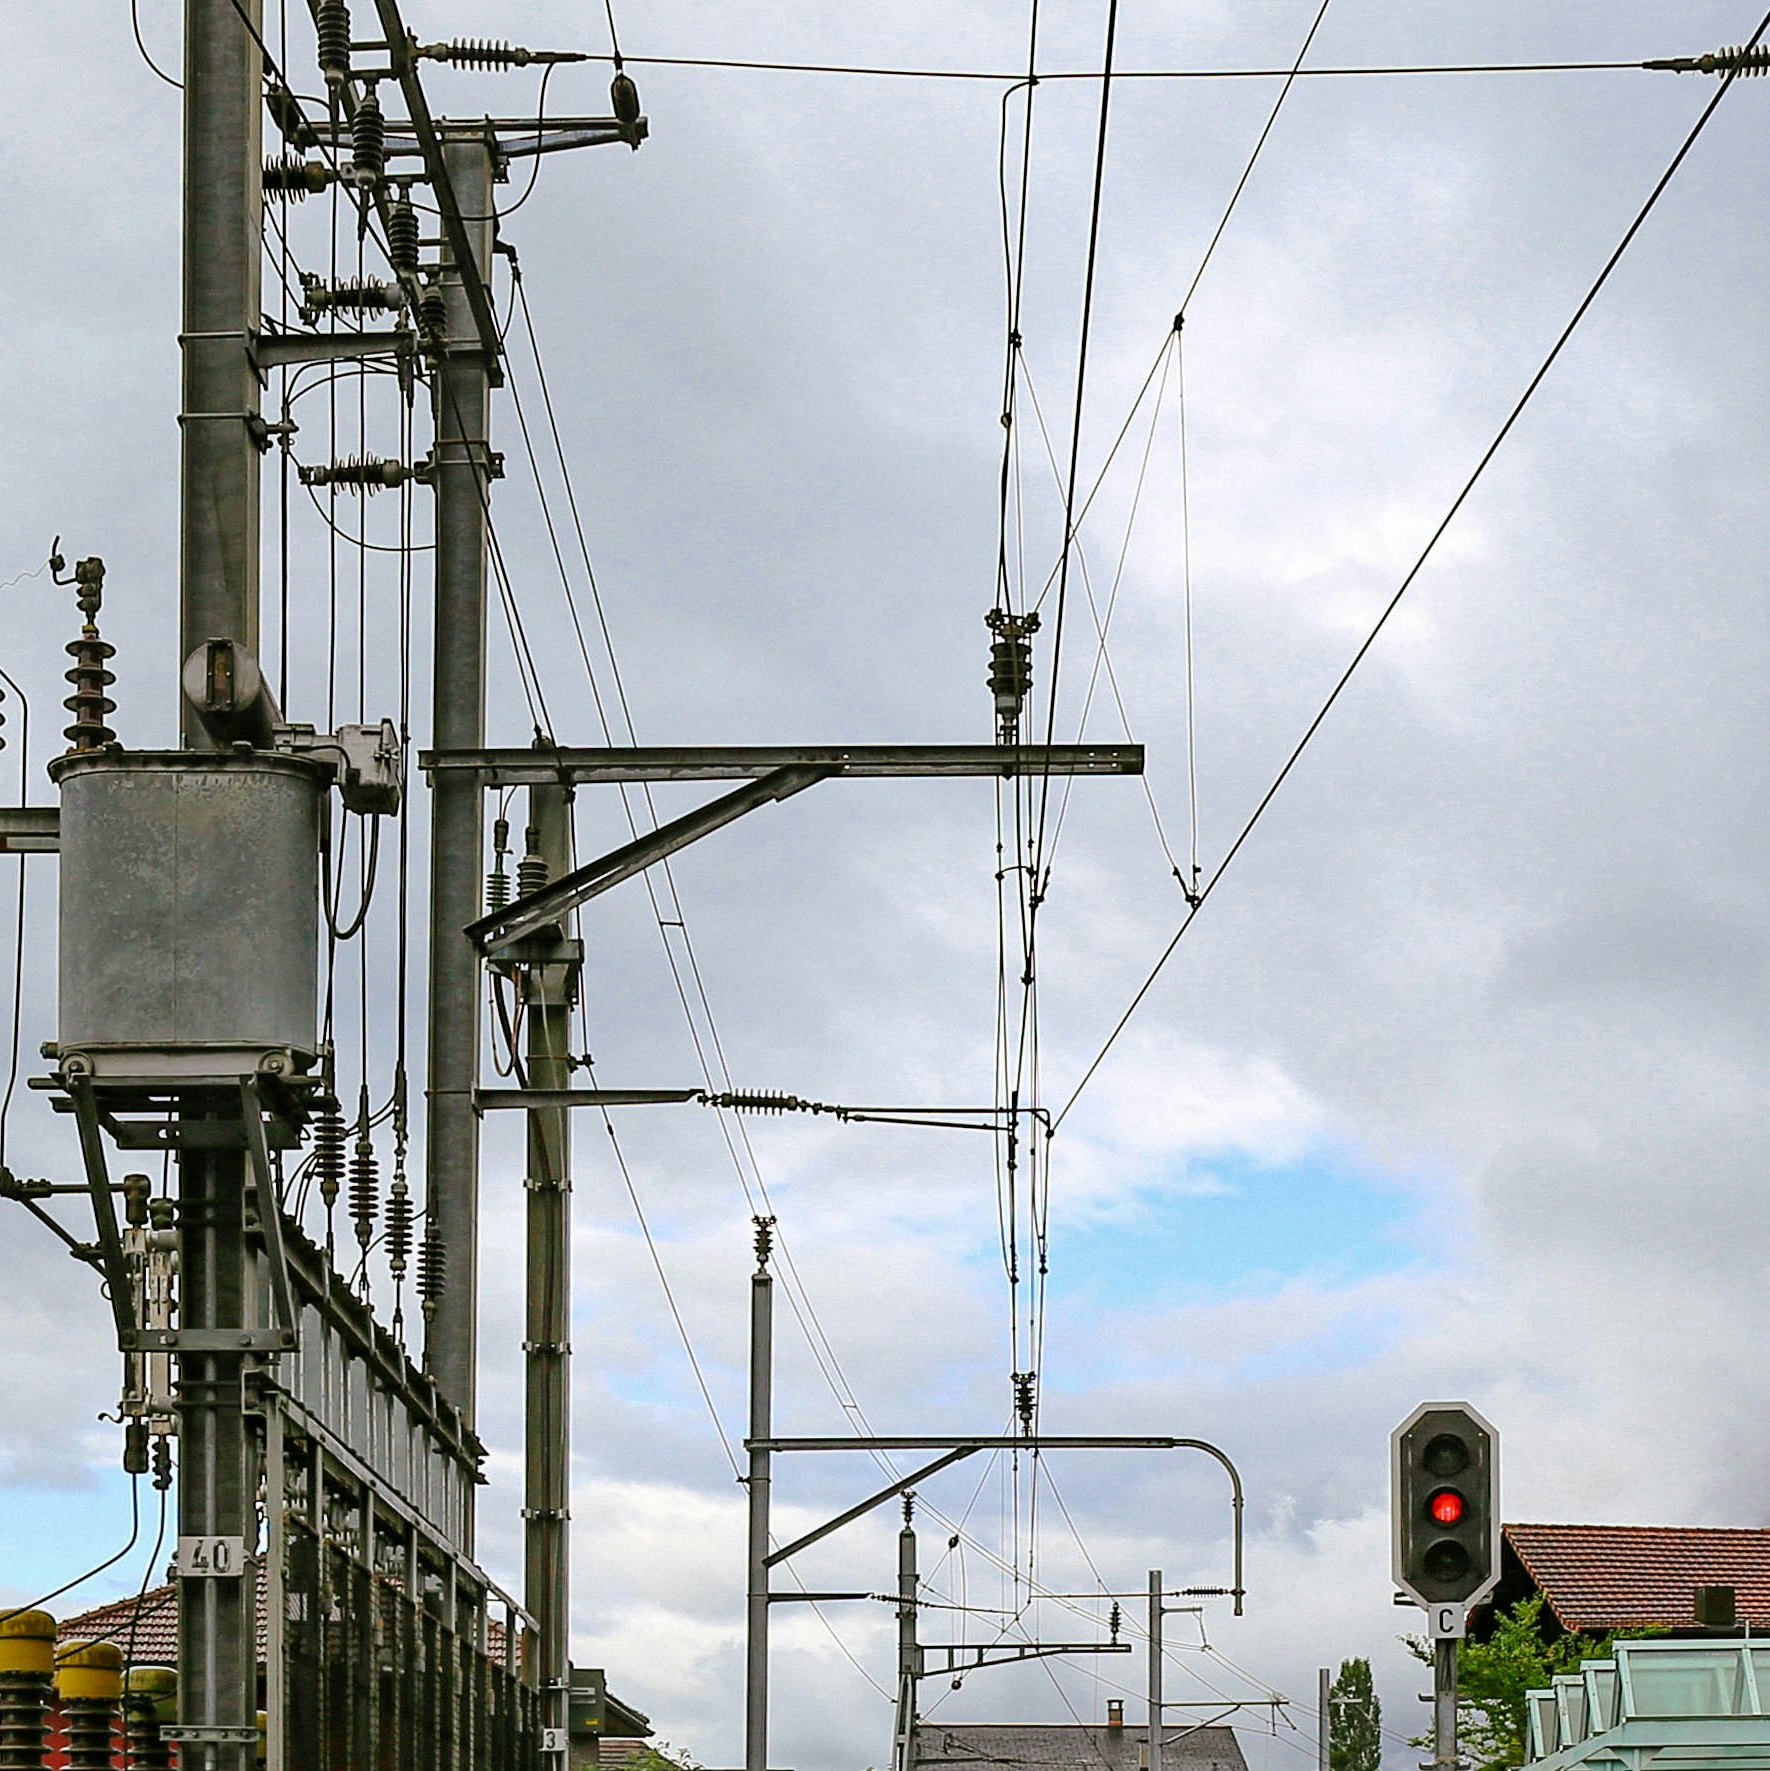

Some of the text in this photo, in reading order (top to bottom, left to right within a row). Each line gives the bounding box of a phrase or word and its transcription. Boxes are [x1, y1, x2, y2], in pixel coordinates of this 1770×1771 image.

[191, 1539, 230, 1574] 40
[1439, 1608, 1454, 1634] C
[545, 1731, 556, 1749] 3
